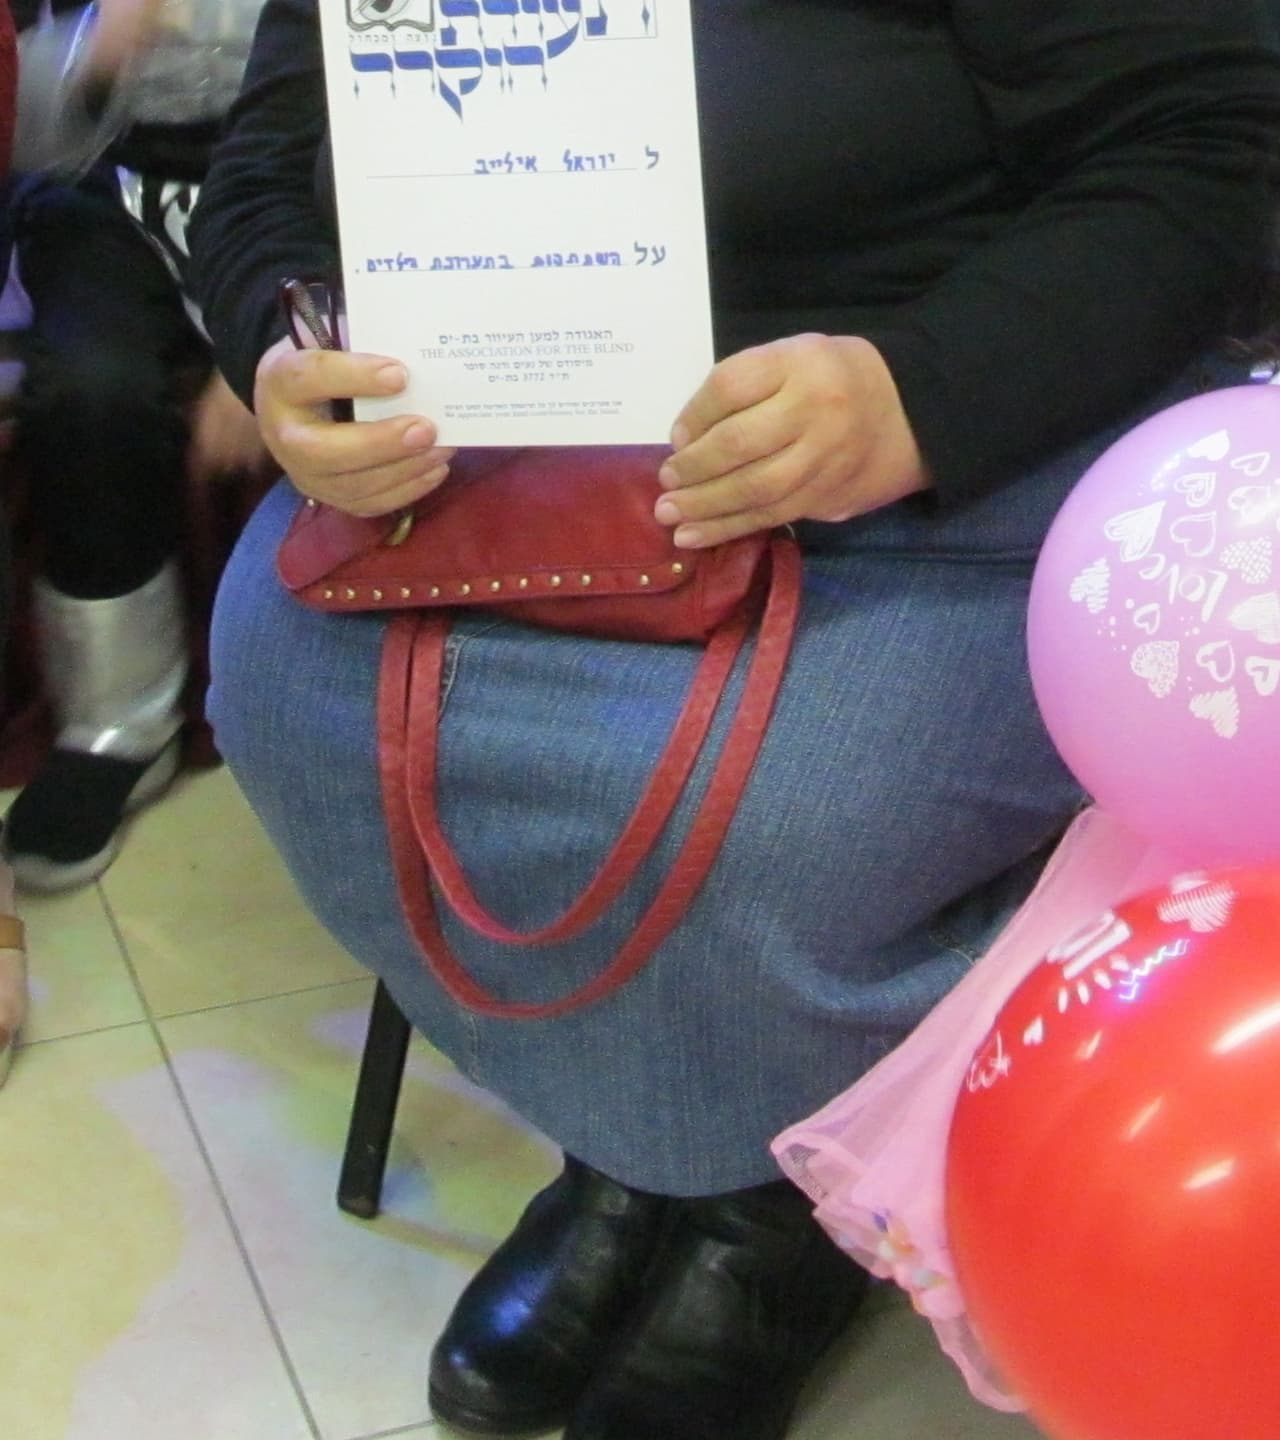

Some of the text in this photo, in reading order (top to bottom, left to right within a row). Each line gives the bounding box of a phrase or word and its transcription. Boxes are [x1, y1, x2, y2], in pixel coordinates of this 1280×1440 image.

[633, 240, 666, 266] על
[529, 329, 560, 344] למען
[420, 342, 635, 359] THE ASSOCIATION FOR THE BLIND
